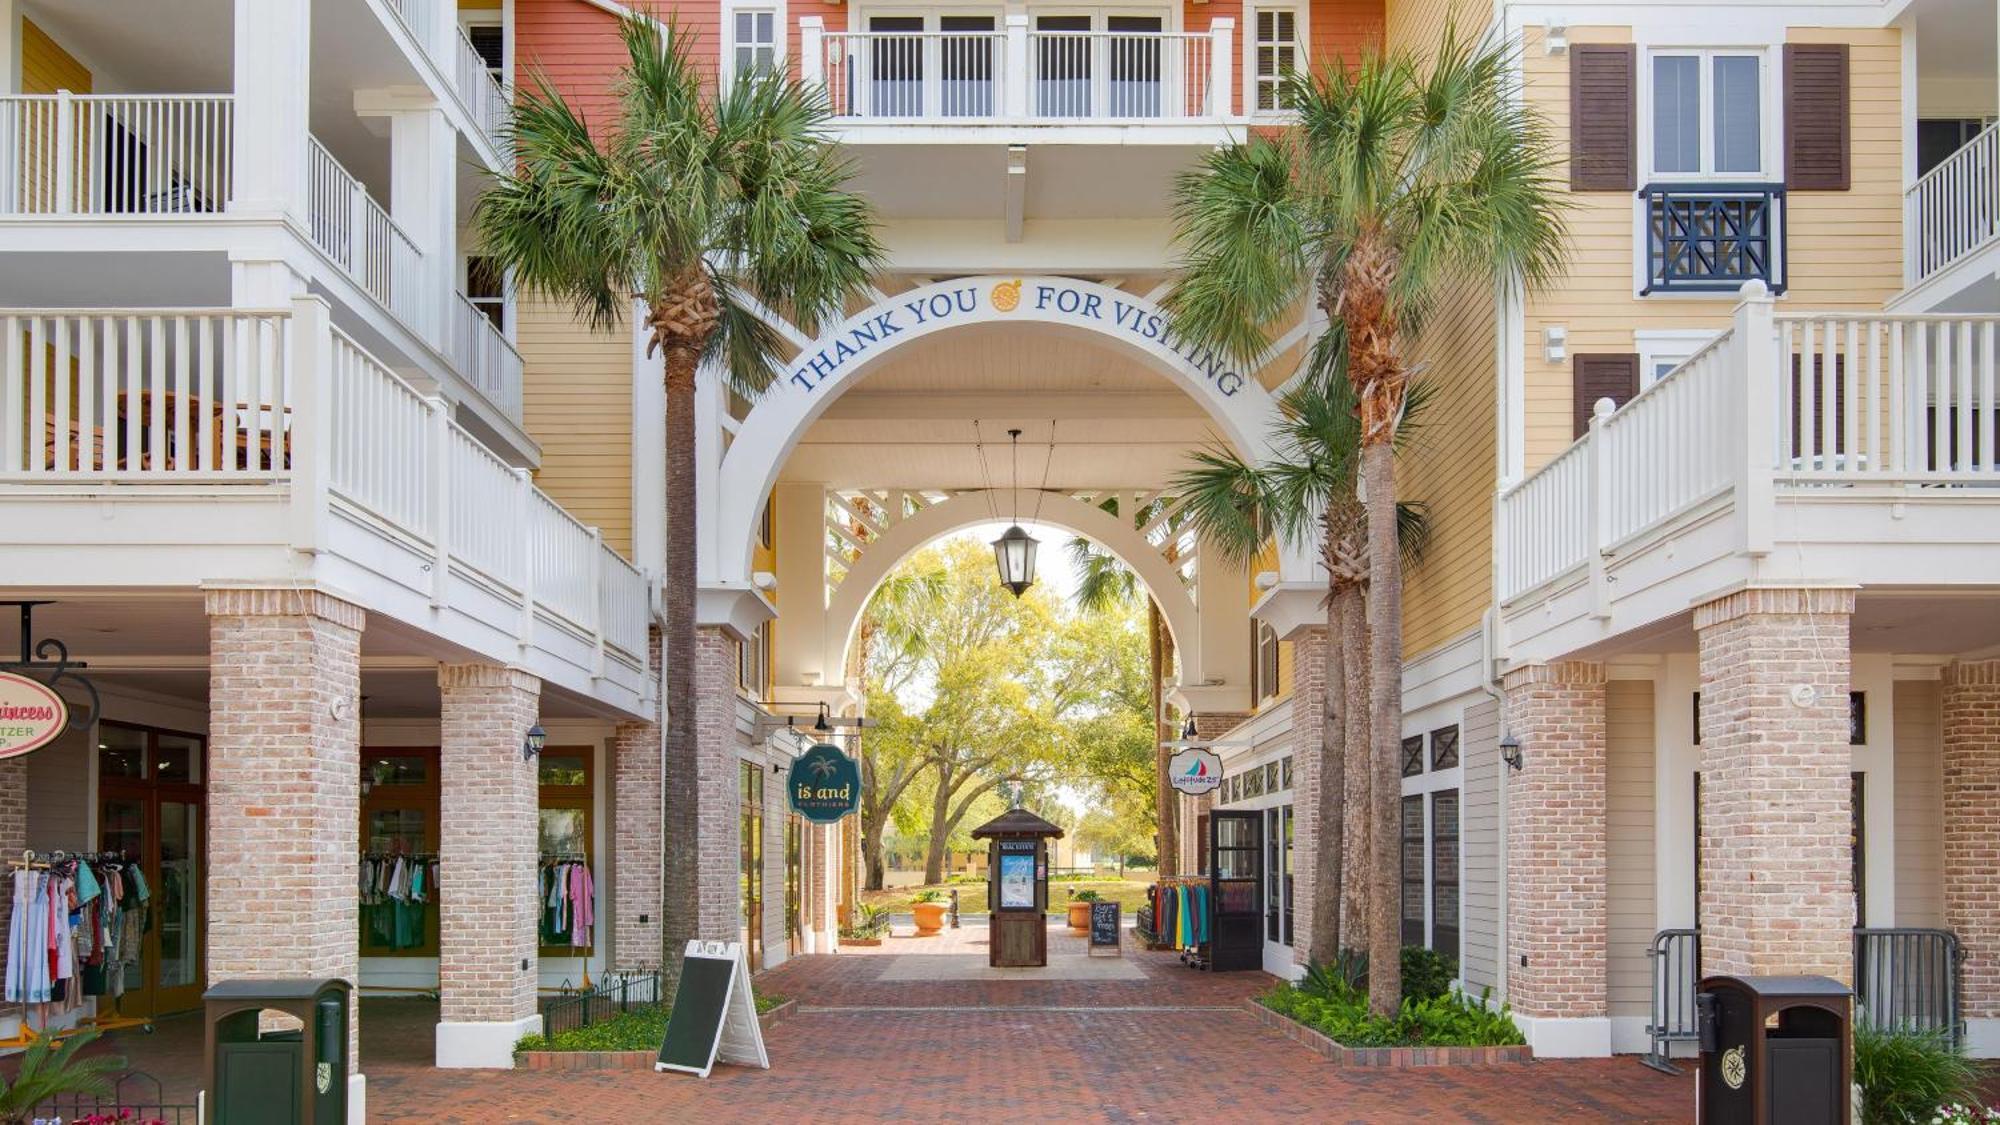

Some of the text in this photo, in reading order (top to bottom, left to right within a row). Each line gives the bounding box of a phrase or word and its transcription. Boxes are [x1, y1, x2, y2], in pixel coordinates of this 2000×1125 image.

[791, 310, 904, 393] THANK
[905, 287, 978, 324] YOU
[1035, 286, 1103, 320] FOR
